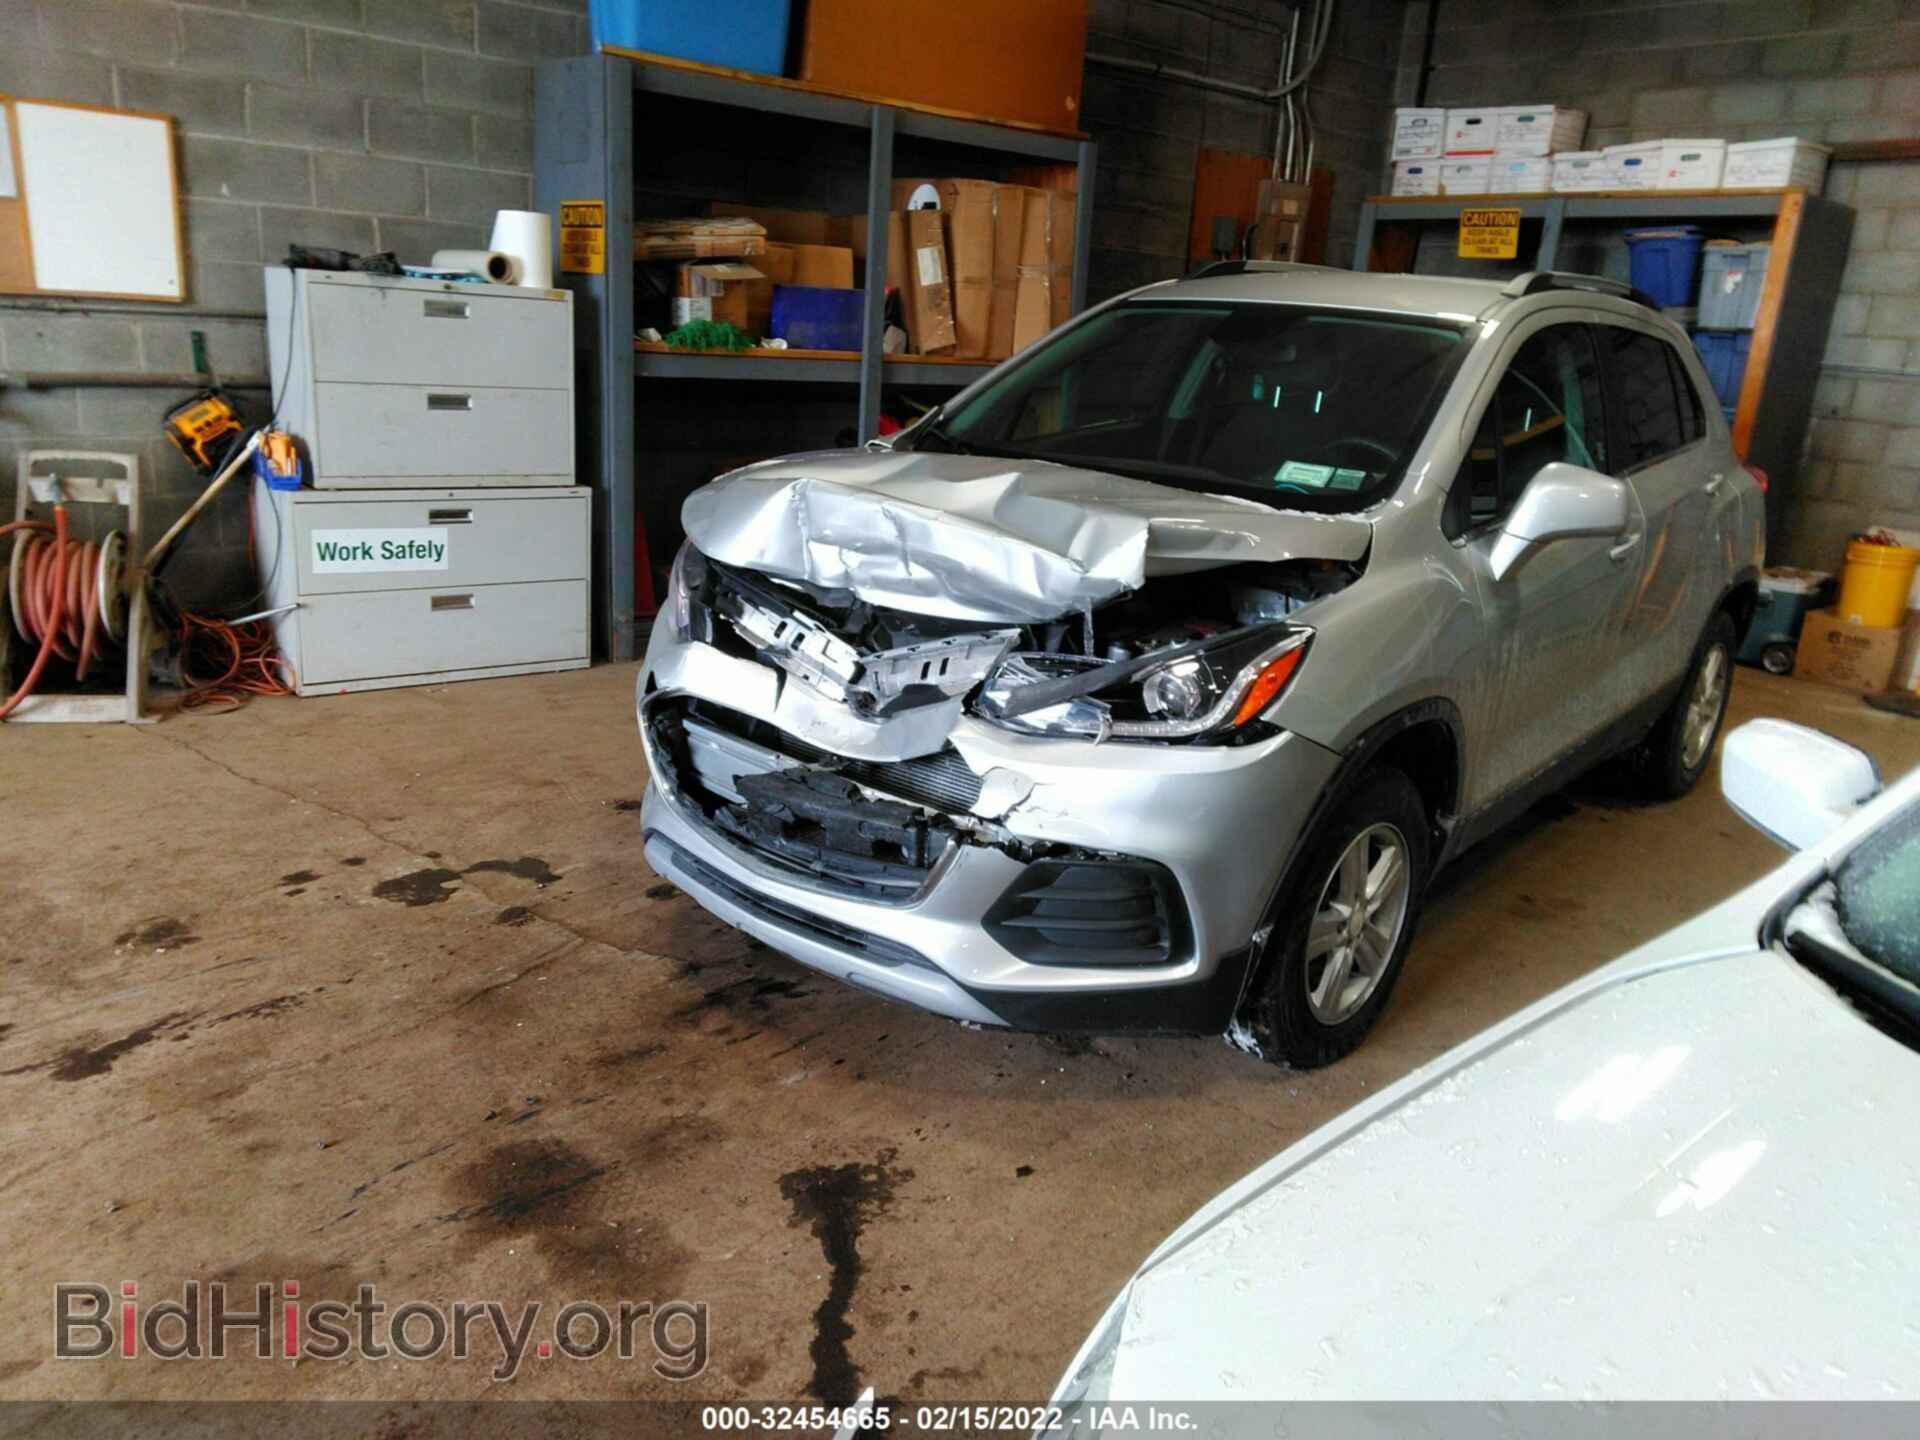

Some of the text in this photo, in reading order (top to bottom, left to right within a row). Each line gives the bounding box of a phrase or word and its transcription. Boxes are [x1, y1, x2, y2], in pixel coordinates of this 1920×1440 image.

[1463, 212, 1516, 225] CAUTION
[316, 539, 446, 563] Work Safely
